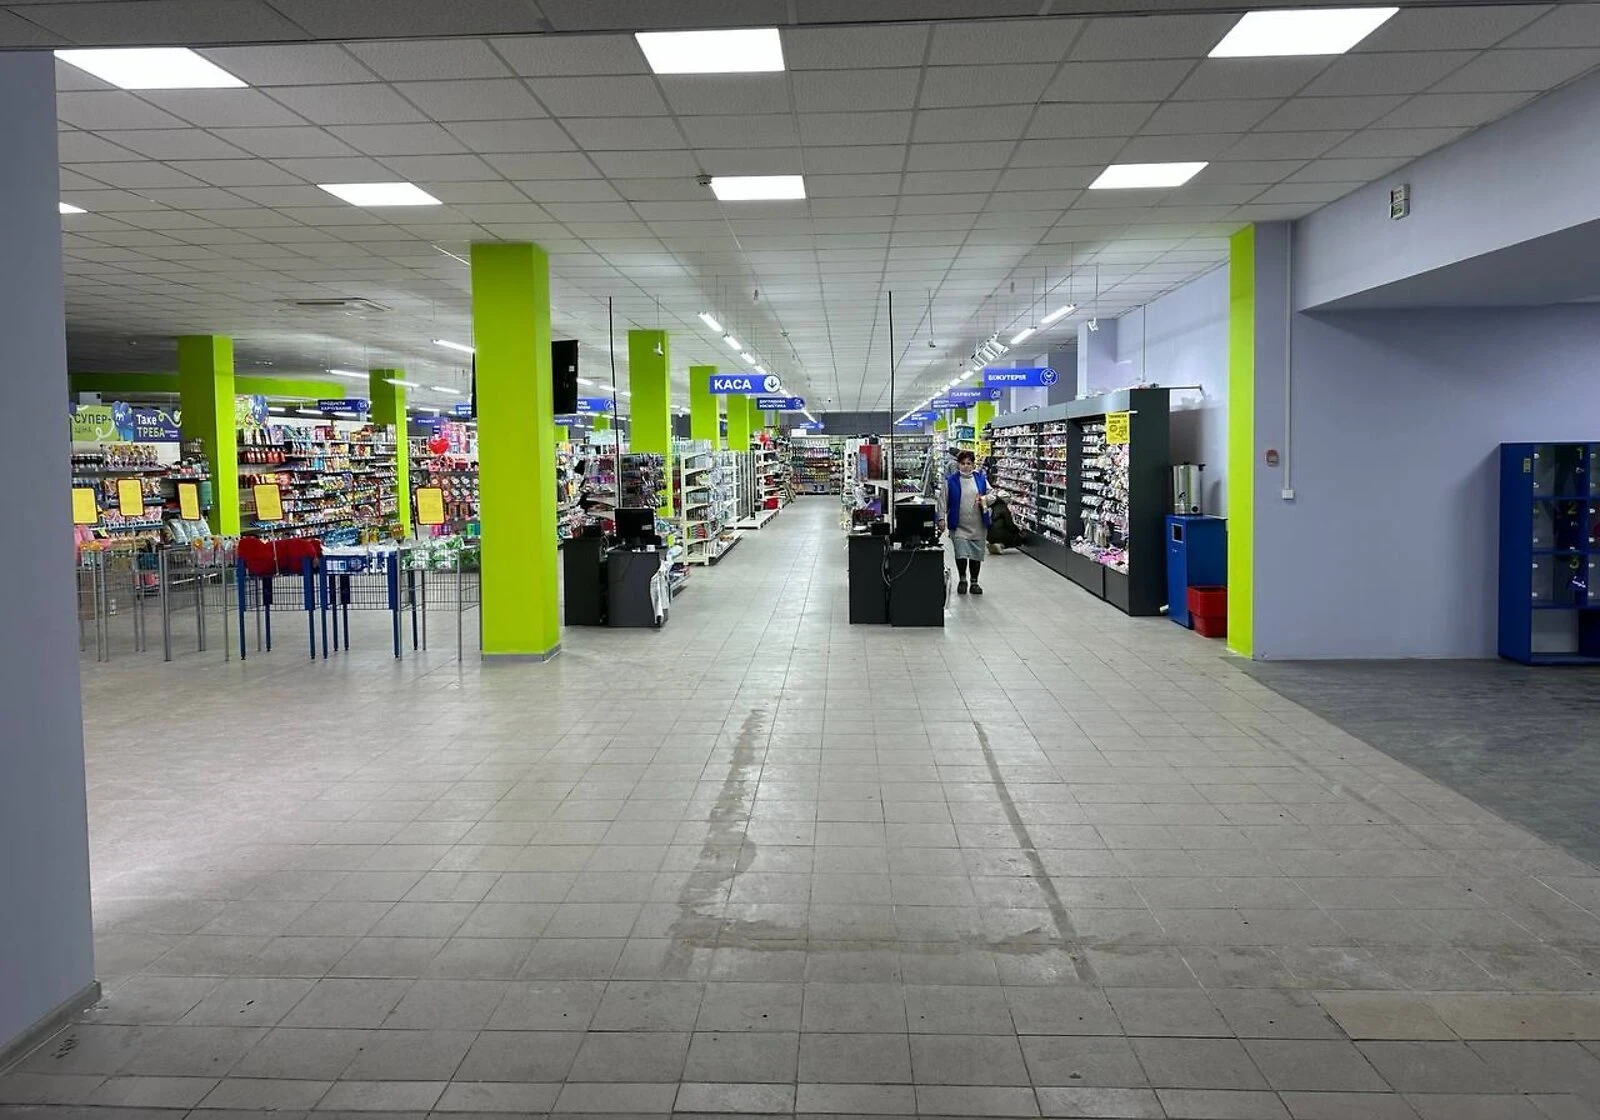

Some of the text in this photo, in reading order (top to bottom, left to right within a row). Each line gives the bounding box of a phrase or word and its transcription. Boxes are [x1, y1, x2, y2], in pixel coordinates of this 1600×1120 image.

[714, 379, 752, 390] КАСА
[74, 414, 111, 424] СУПЕР-
[136, 414, 157, 425] Таке
[137, 427, 165, 438] ТРЕБА
